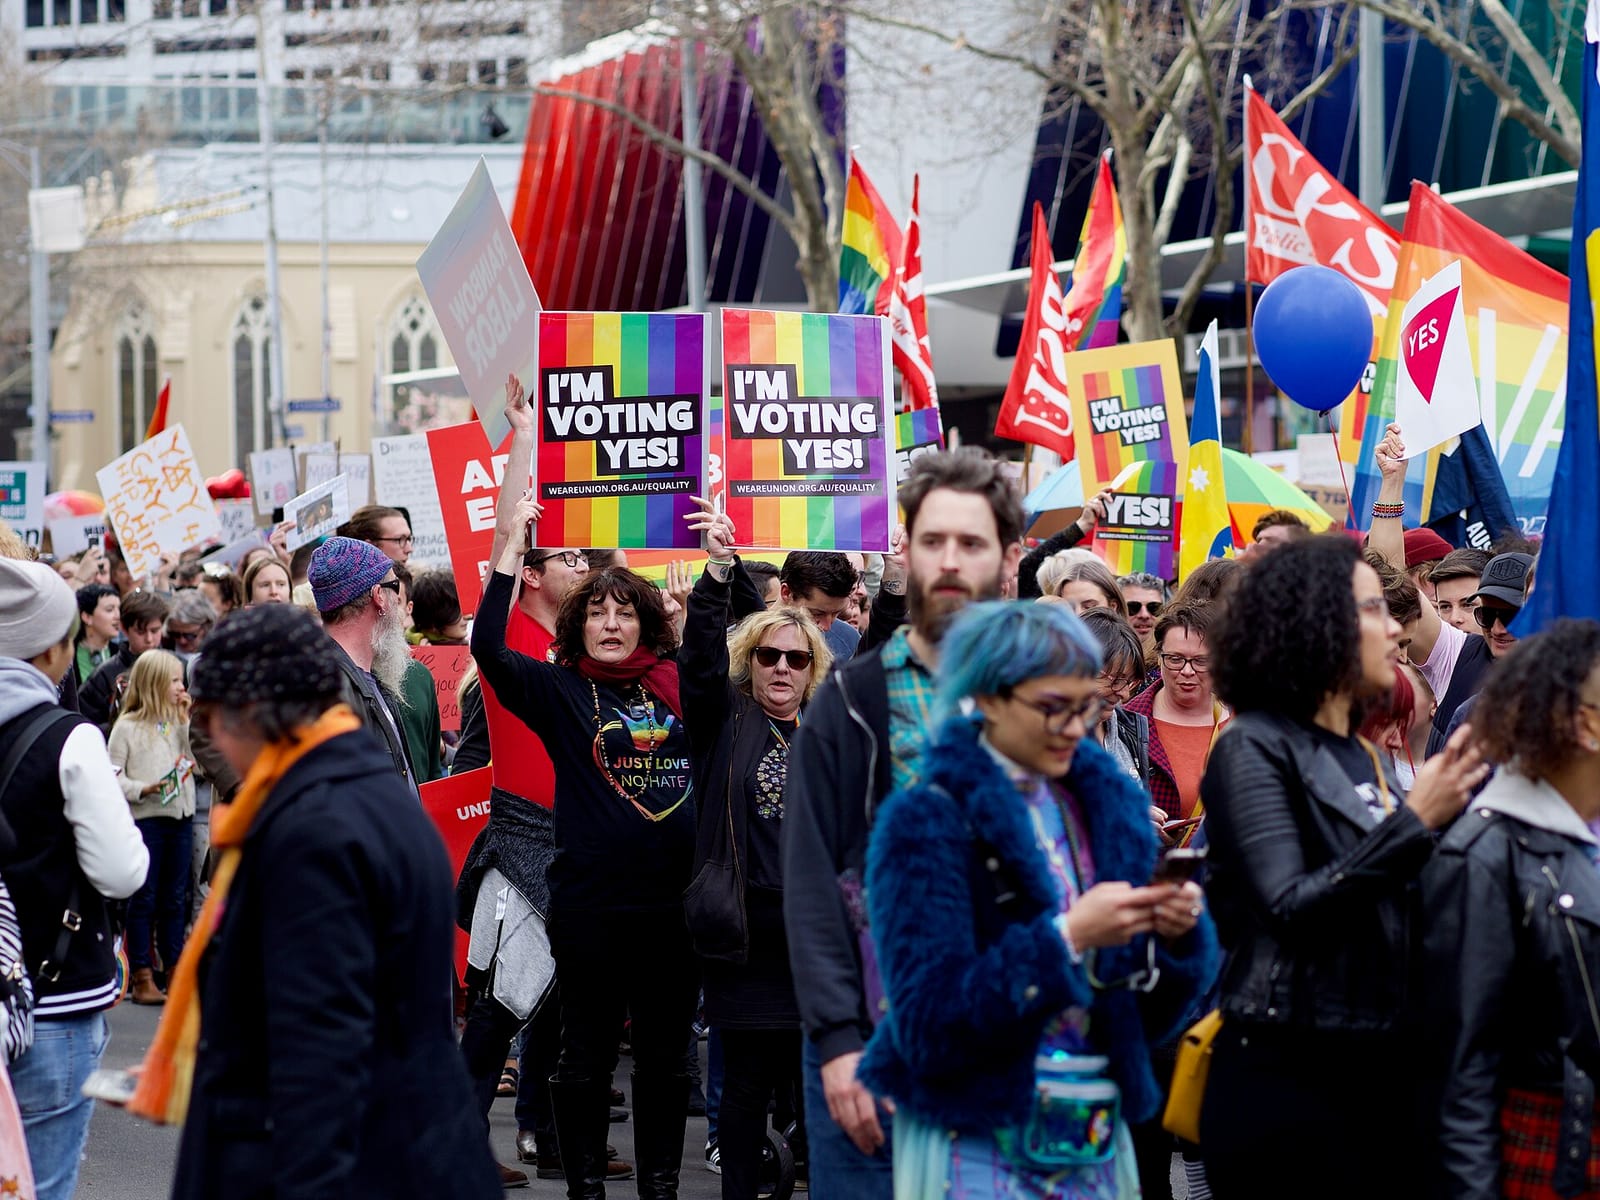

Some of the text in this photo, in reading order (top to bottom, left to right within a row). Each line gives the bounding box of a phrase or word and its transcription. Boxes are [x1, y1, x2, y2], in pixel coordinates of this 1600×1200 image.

[1408, 317, 1440, 358] YES
[548, 372, 604, 404] I'M
[733, 370, 789, 400] I'M
[546, 400, 694, 437] VOTING
[733, 402, 877, 434] VOTING
[1089, 397, 1121, 417] I'M
[1091, 404, 1167, 433] VOTING
[1120, 423, 1161, 445] YES!
[600, 436, 679, 470] YES!
[787, 438, 864, 470] YES!
[548, 480, 690, 496] WEAREUNION.ORG.AU/EQUALITY
[736, 482, 877, 494] WEAREUNION.ORG.AU/EQUALITY
[115, 462, 160, 556] HIP HIP
[1103, 496, 1171, 527] YES!
[108, 492, 147, 574] HOORAY
[613, 756, 690, 770] JUST LOVE
[621, 774, 687, 788] NO HATE
